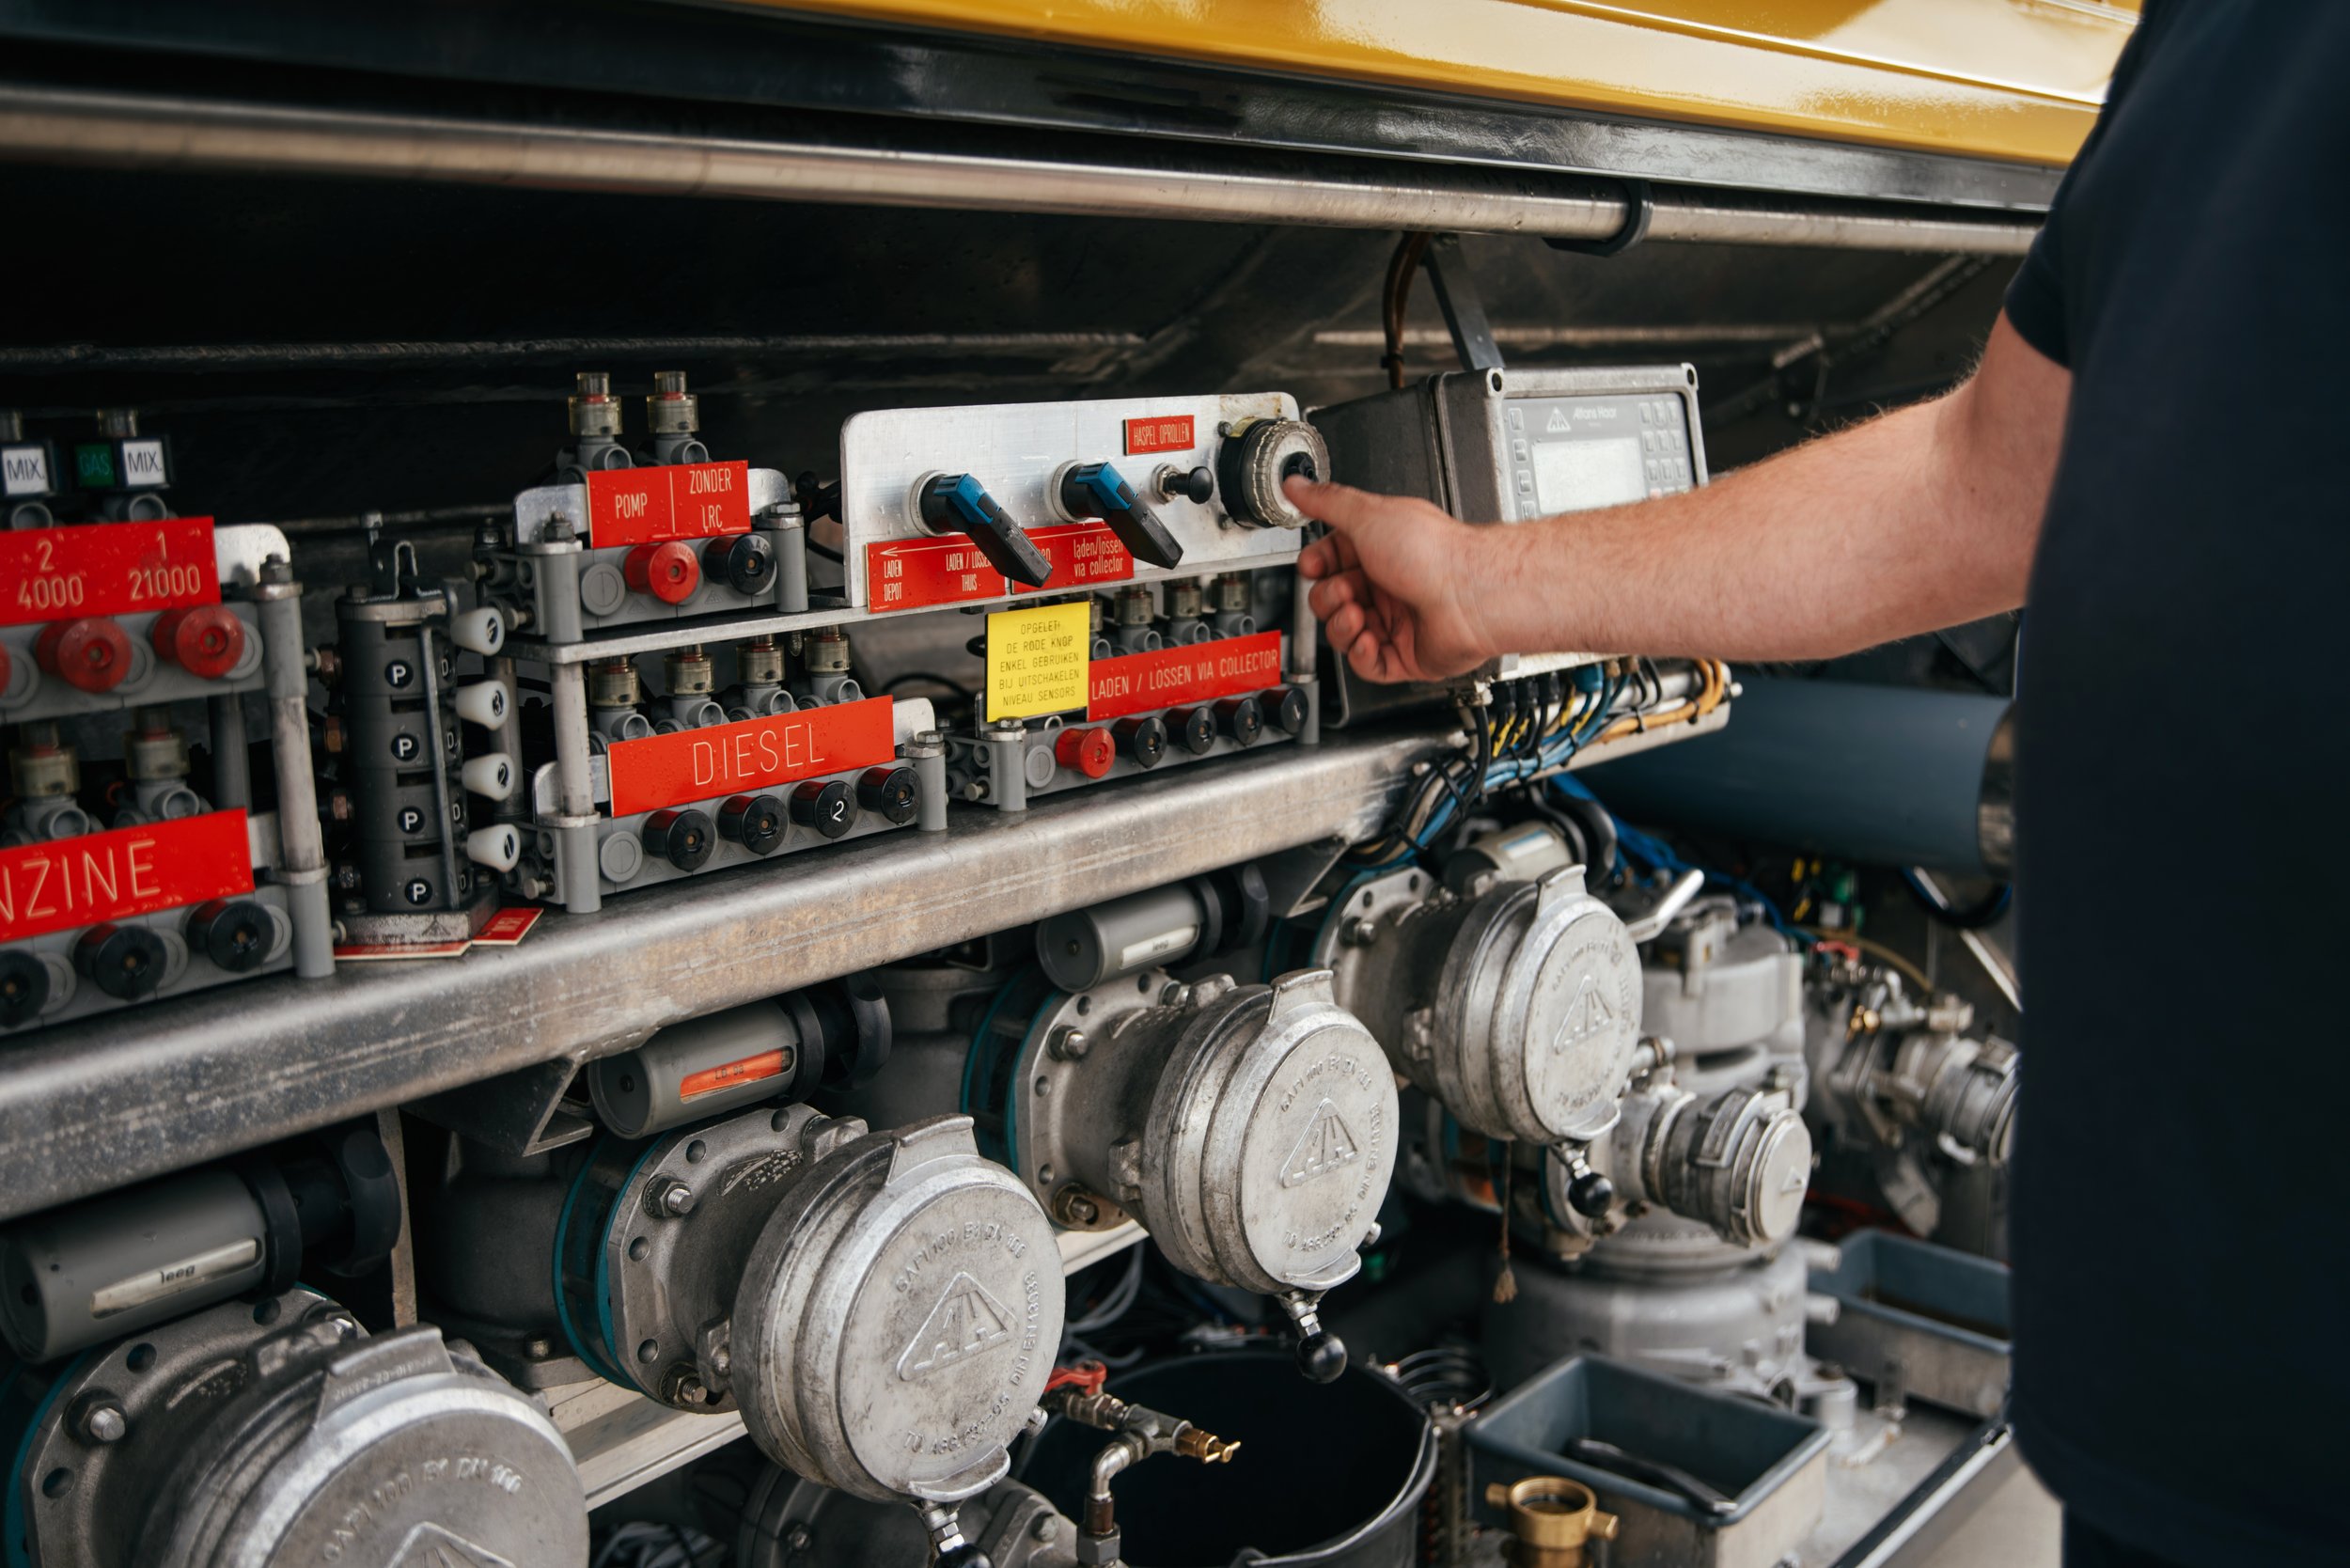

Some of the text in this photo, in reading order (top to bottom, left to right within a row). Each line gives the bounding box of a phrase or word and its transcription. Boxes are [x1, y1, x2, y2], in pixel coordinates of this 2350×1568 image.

[1134, 422, 1190, 447] HASPEL OPROLLEN
[689, 468, 732, 494] ZONDER
[615, 493, 648, 520] POMP
[702, 504, 723, 530] LRC
[37, 539, 55, 572] 2
[156, 530, 166, 560] 1
[884, 559, 902, 579] LADEN
[946, 553, 964, 572] LADEN
[1073, 556, 1123, 578] via collector
[18, 574, 84, 610] 4000
[128, 565, 201, 602] 21000
[884, 583, 902, 603] DEPOT
[962, 574, 978, 592] THUIS
[1007, 635, 1073, 654] DE RODE KNOP
[1000, 652, 1079, 672] ENKEL GEBRUIKEN
[392, 665, 406, 683] P
[999, 669, 1080, 690] BIJ UITSCHAKELEN
[1091, 649, 1278, 700] LADEN / LOSSEN VIA COLLECTOR
[493, 691, 502, 714] 3
[1003, 686, 1075, 707] NIVEAU SENSORS
[399, 738, 413, 757] P
[693, 723, 825, 787] DIESEL
[498, 764, 508, 786] 2
[404, 811, 418, 831] P
[832, 800, 844, 823] 2
[506, 837, 514, 856] 1
[413, 884, 426, 902] P
[1009, 1356, 1028, 1387] DIN
[1022, 1325, 1037, 1352] EN
